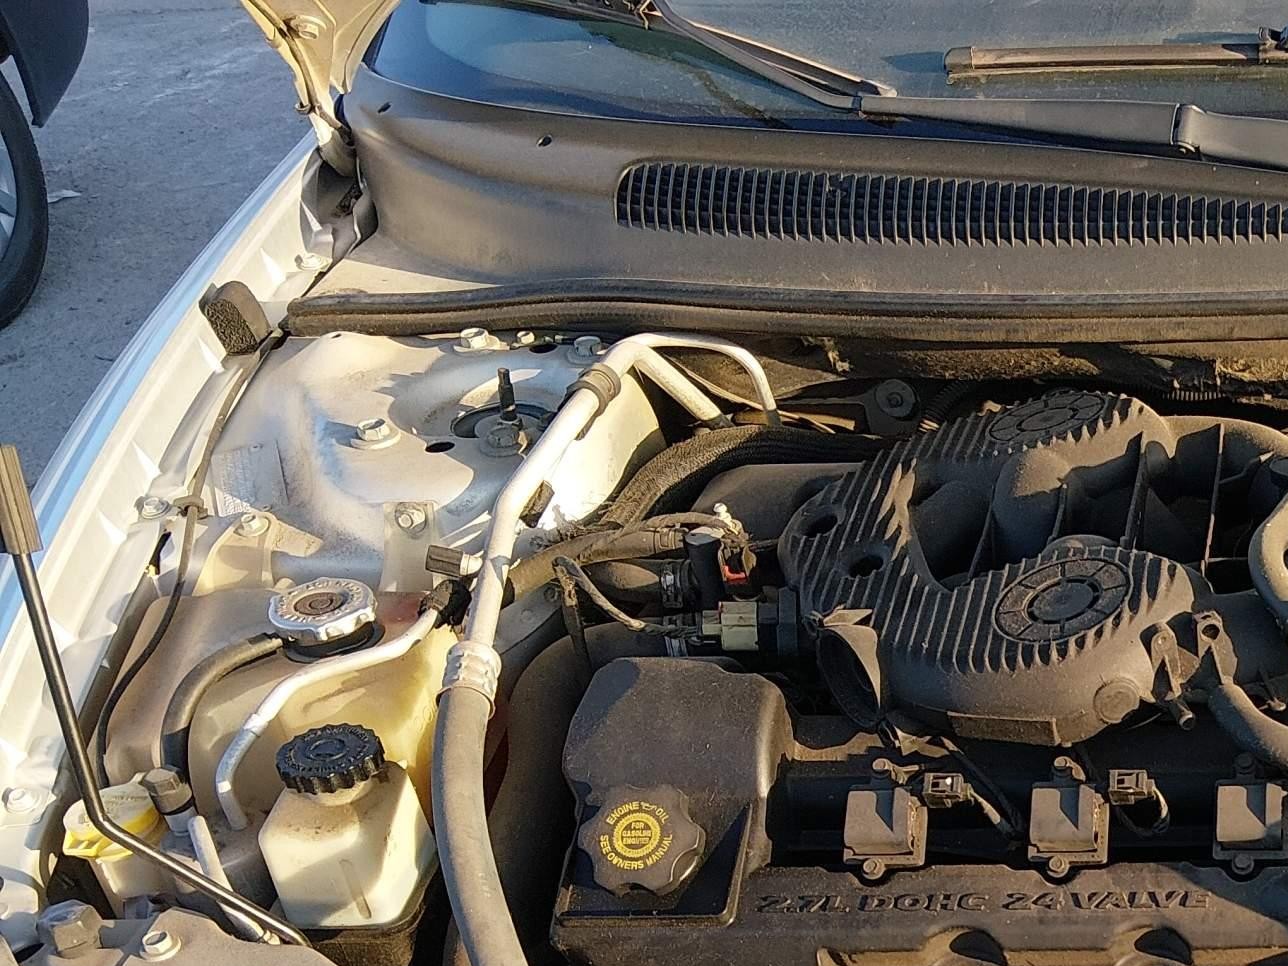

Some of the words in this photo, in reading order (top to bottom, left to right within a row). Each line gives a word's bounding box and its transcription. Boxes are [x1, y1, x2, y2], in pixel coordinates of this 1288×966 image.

[605, 801, 640, 825] ENGINE
[655, 807, 670, 825] OIL
[600, 834, 612, 855] SEE
[607, 852, 645, 870] OWNERS
[645, 834, 673, 866] MANUAL
[857, 893, 990, 913] DOHC
[1001, 892, 1066, 912] 24
[1070, 889, 1214, 910] VALVE
